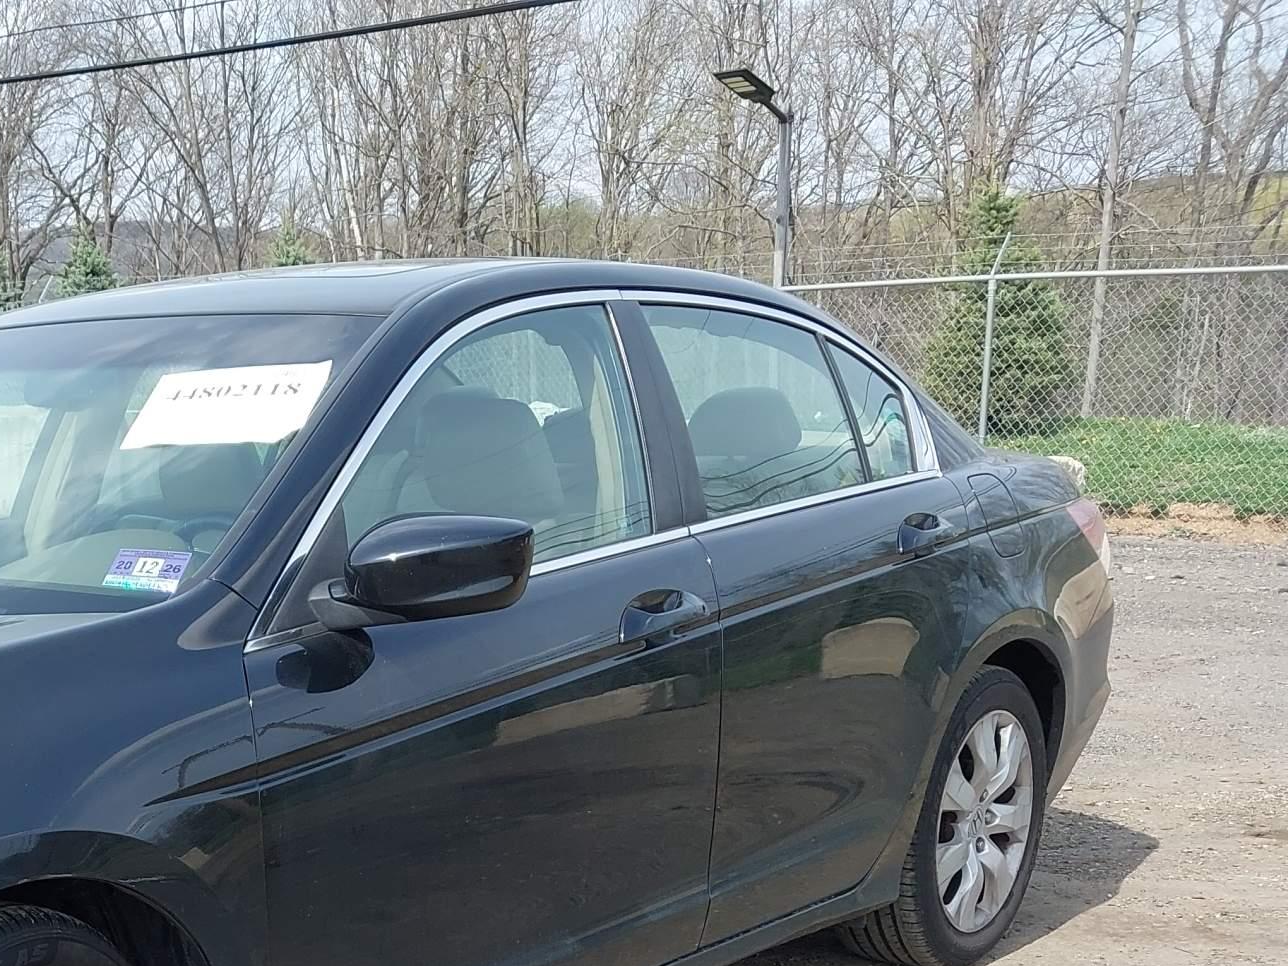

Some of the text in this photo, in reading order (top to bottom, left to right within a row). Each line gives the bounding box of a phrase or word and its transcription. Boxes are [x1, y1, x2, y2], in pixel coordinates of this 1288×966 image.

[166, 382, 302, 401] 44802118
[115, 560, 182, 574] 20 12 26
